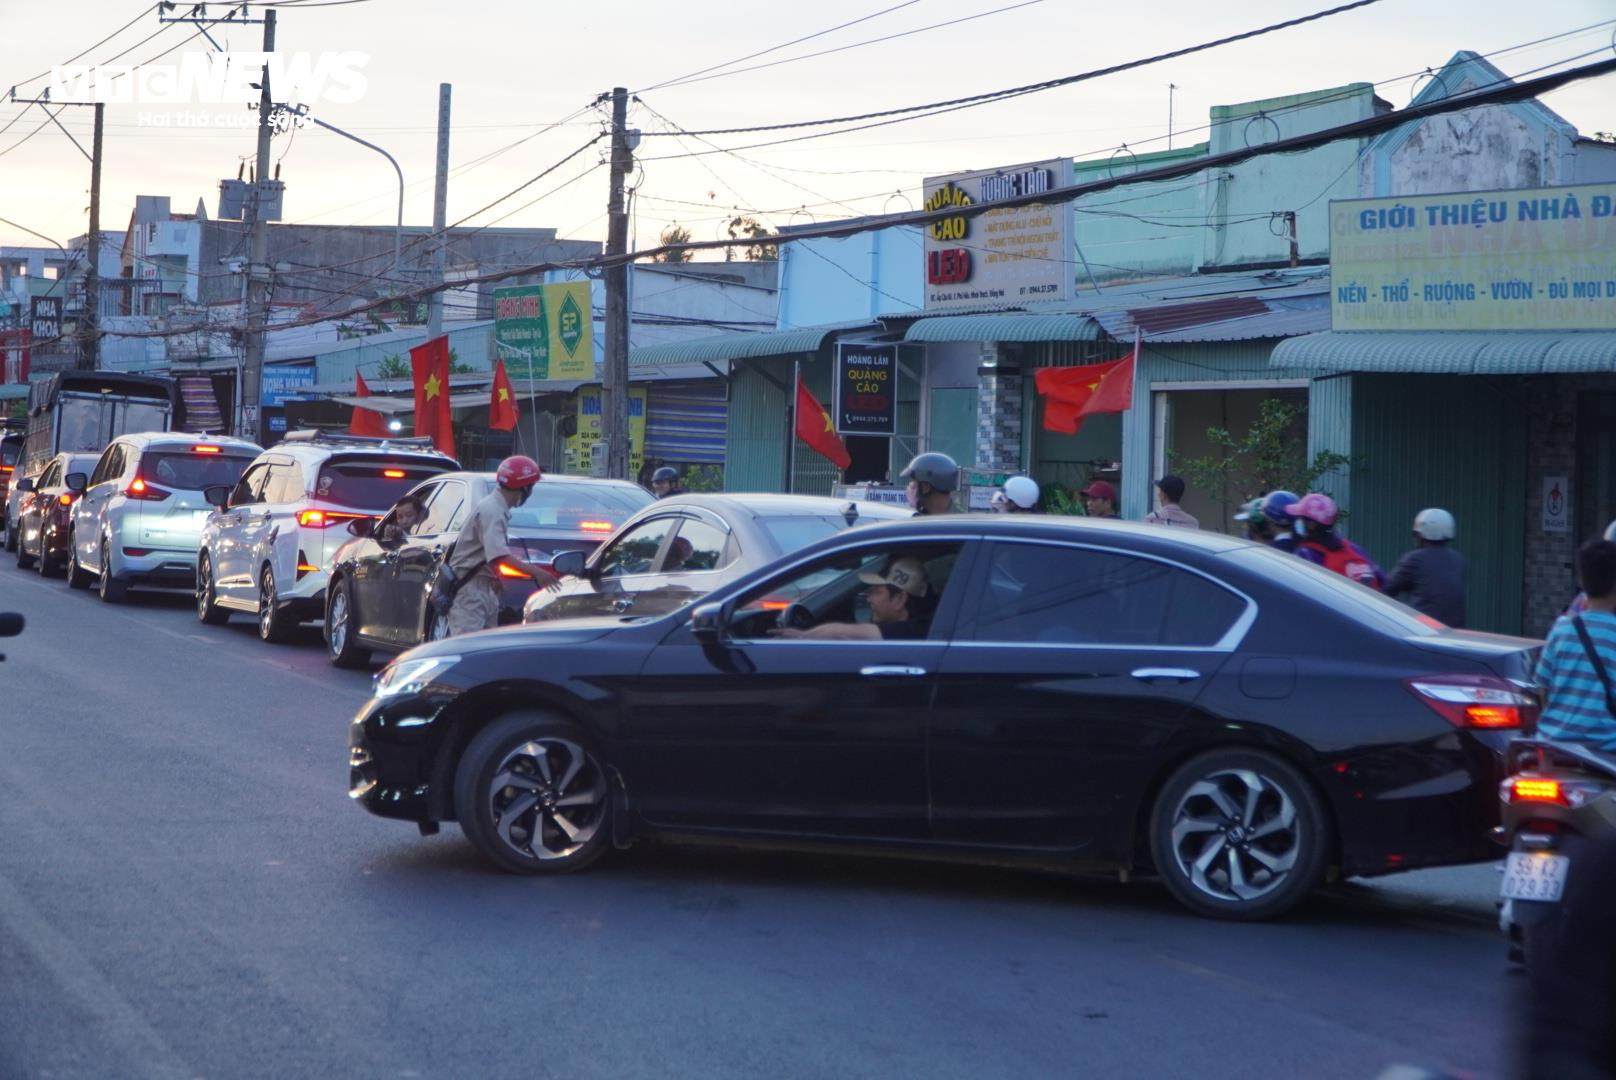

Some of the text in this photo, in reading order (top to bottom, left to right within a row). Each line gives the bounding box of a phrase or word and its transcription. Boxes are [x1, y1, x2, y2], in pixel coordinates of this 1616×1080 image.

[1360, 203, 1416, 230] GIỚI
[1424, 199, 1507, 229] THIỆU
[1518, 192, 1582, 221] NHÀ
[927, 248, 971, 285] LED
[1424, 280, 1476, 304] RUỘNG
[1491, 278, 1533, 300] VƯỜN
[1548, 277, 1568, 299] ĐỦ
[1573, 281, 1602, 301] MỌI
[32, 321, 60, 338] KHOA
